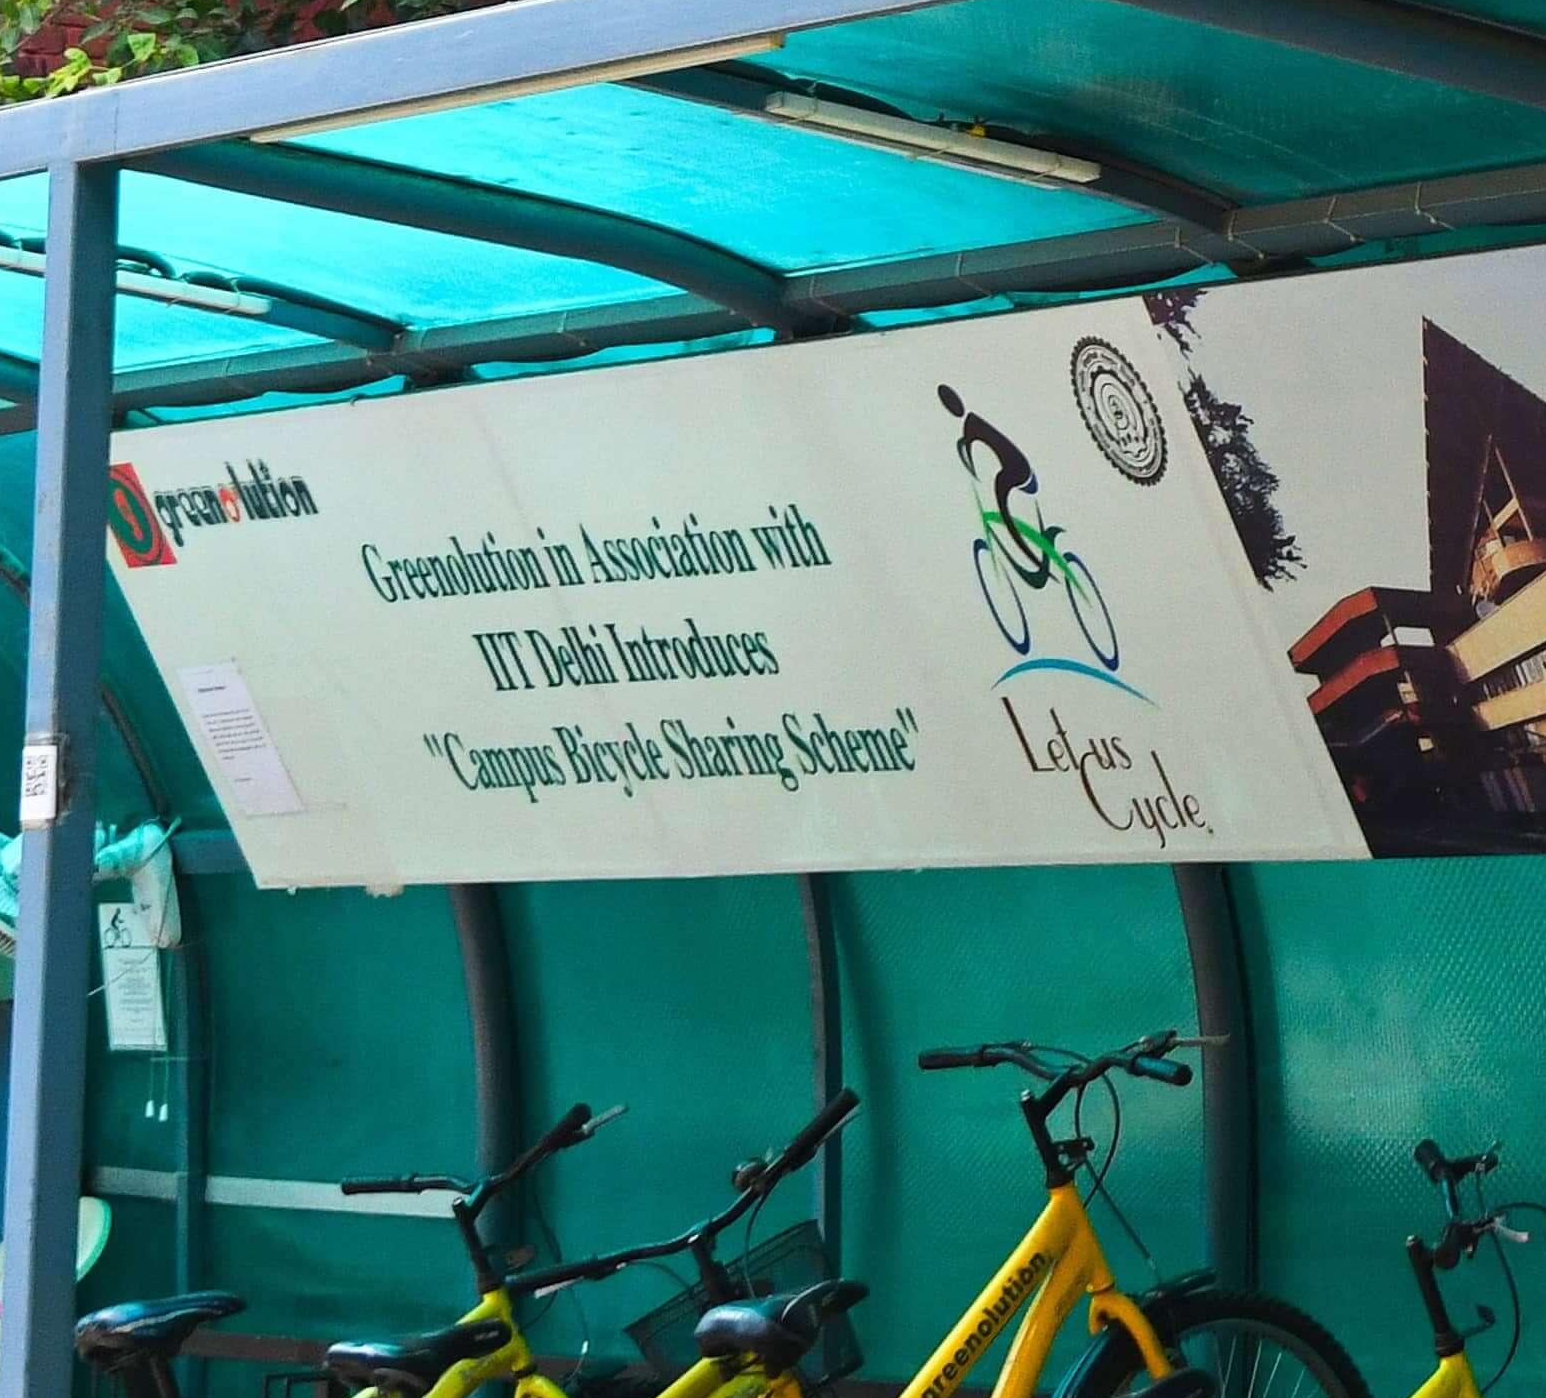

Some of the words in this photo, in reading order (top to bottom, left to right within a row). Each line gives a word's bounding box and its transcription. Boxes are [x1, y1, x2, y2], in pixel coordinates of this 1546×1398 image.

[360, 531, 550, 603] Greenolution
[537, 527, 585, 586] in
[580, 512, 758, 584] Association
[750, 504, 832, 570] with
[472, 631, 535, 691] IIT
[525, 623, 619, 689] Delhi
[604, 618, 780, 683] Introduces
[423, 731, 567, 803] "Campus
[552, 722, 671, 797] Bicycle
[660, 715, 800, 791] Sharing
[782, 707, 918, 775] Scheme"
[1001, 697, 1080, 773] Let
[1088, 734, 1133, 771] us
[1080, 746, 1210, 849] Cycle
